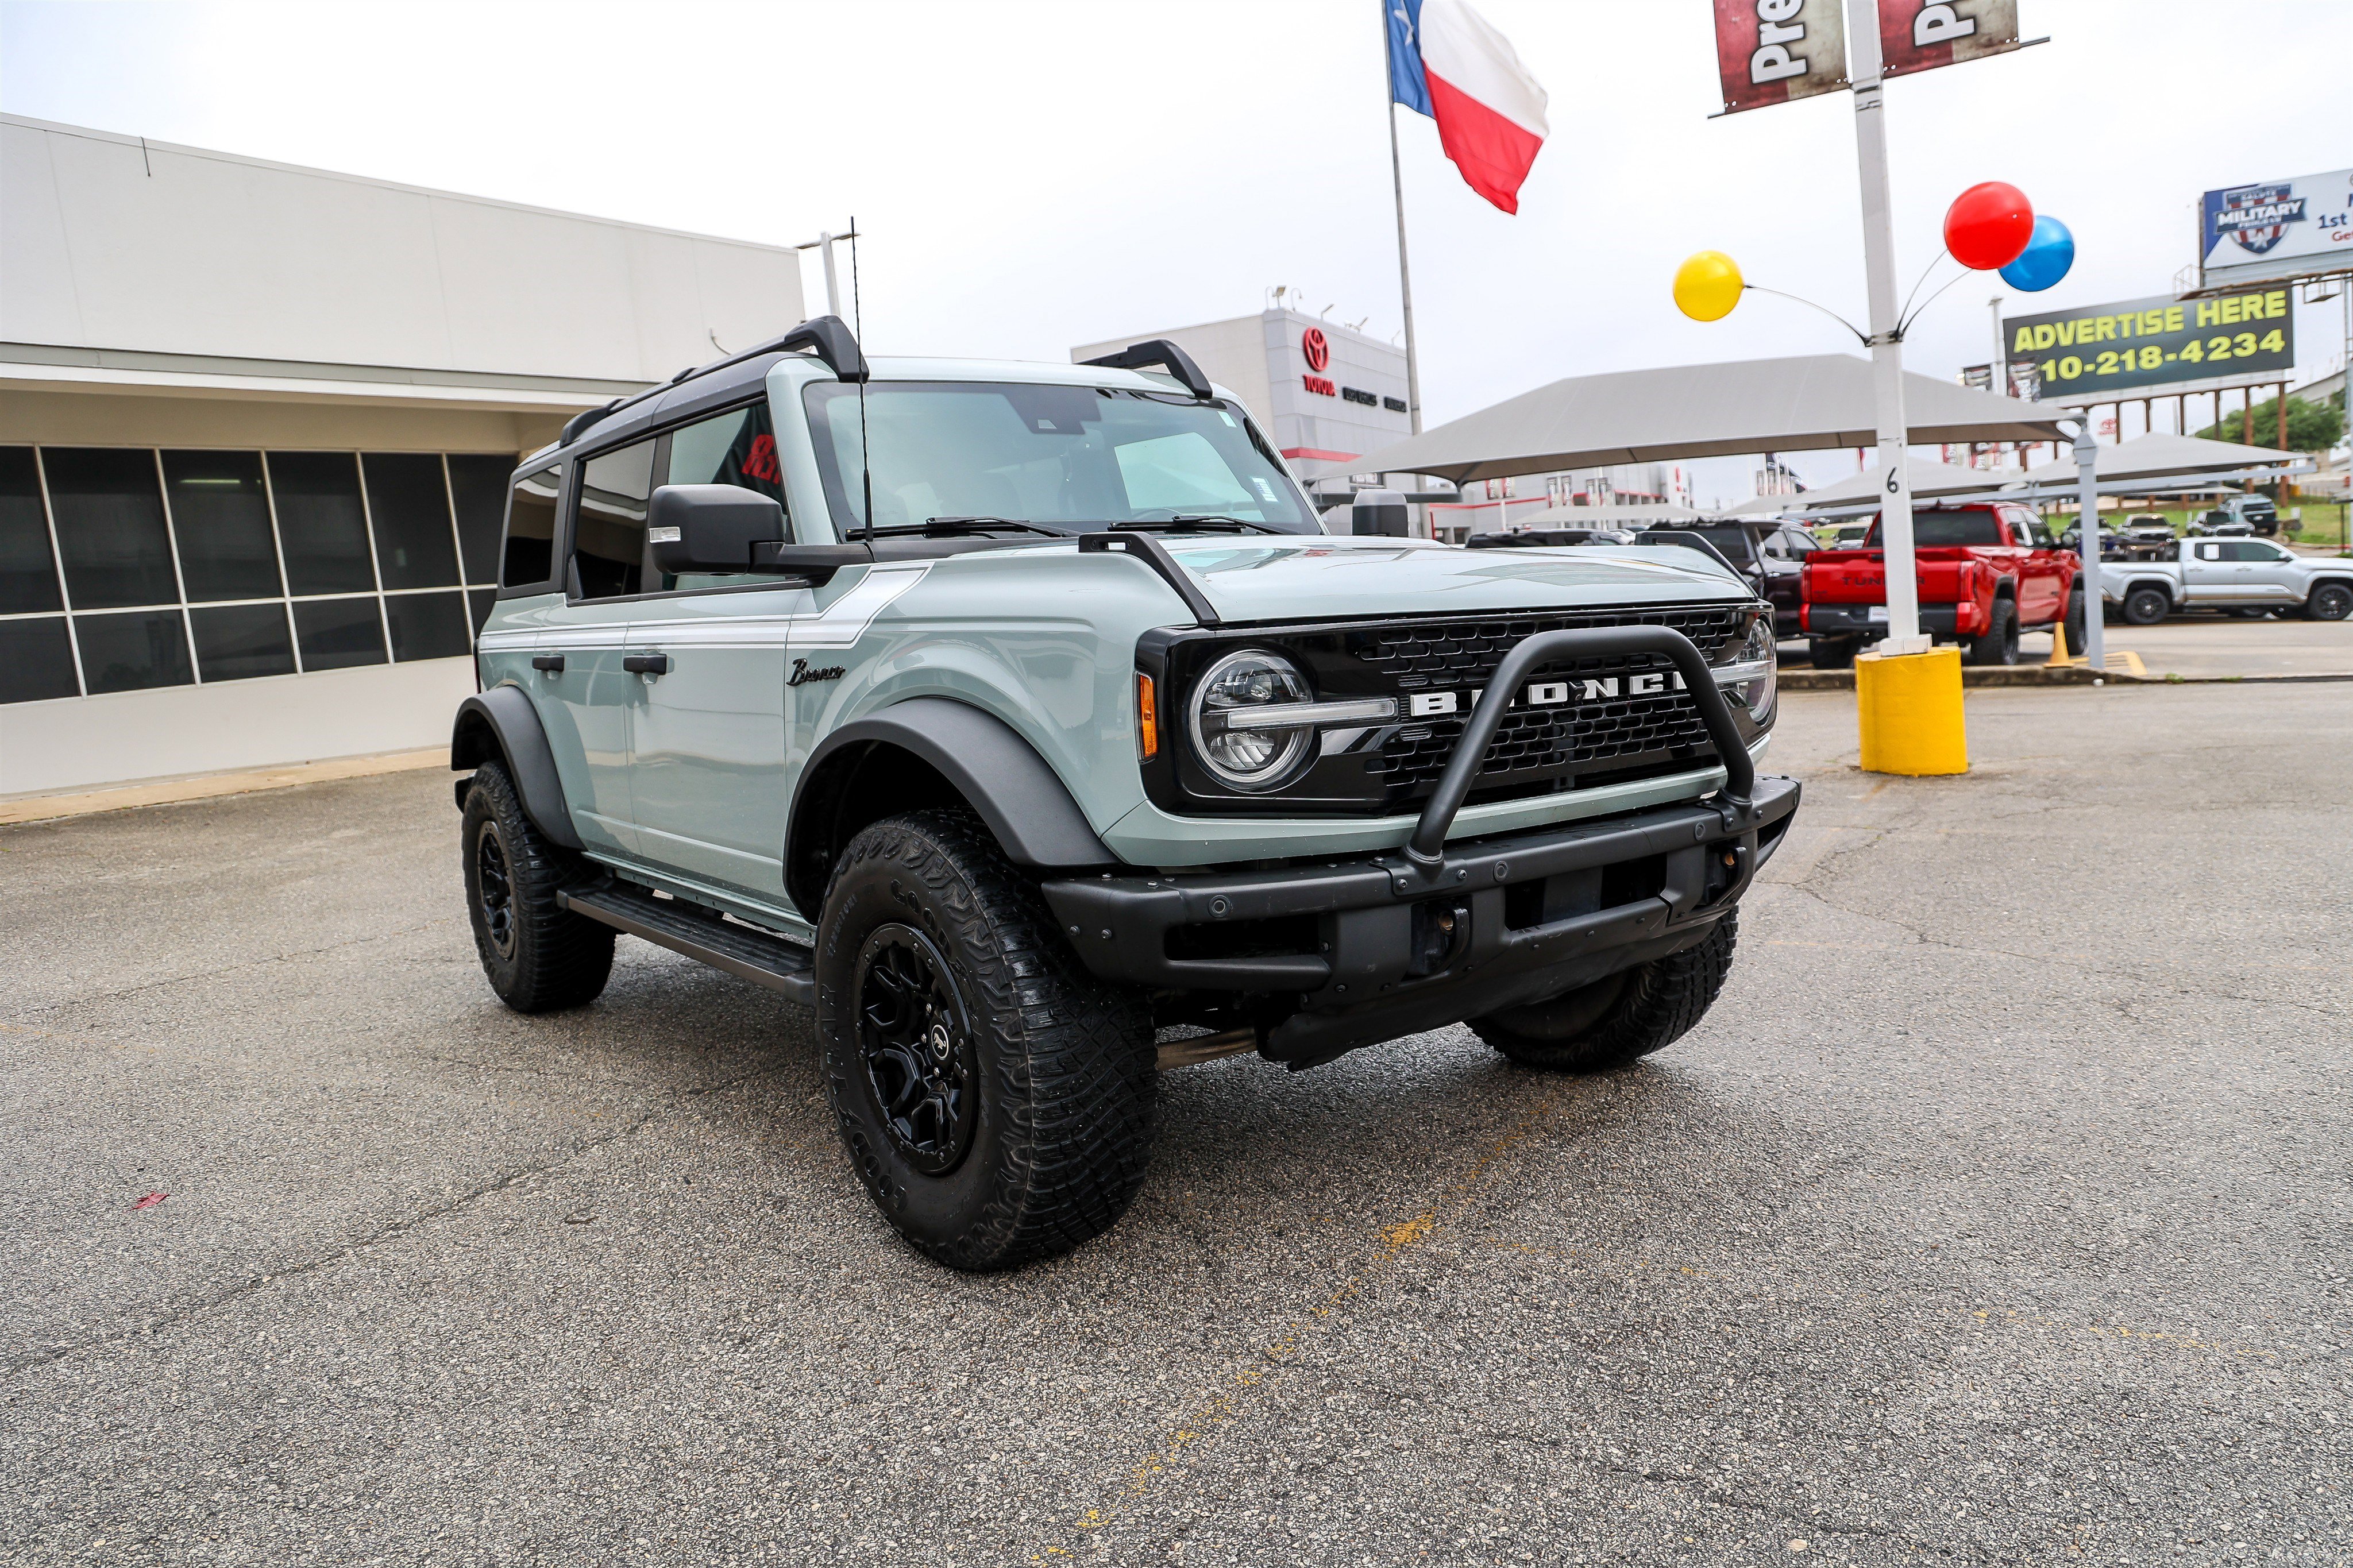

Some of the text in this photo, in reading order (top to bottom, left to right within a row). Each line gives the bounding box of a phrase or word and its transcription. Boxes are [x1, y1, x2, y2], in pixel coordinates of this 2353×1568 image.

[1752, 0, 1807, 83] Pre
[1914, 0, 1974, 46] P
[2217, 201, 2302, 226] MILITARY
[2319, 213, 2347, 229] 1st
[2013, 291, 2286, 353] ADVERTISE HERE
[2039, 329, 2285, 382] 10-218-4234
[1302, 373, 1337, 396] TOYOTA
[1887, 465, 1898, 493] 6
[786, 658, 846, 686] Bronco
[1410, 671, 1687, 717] BONC
